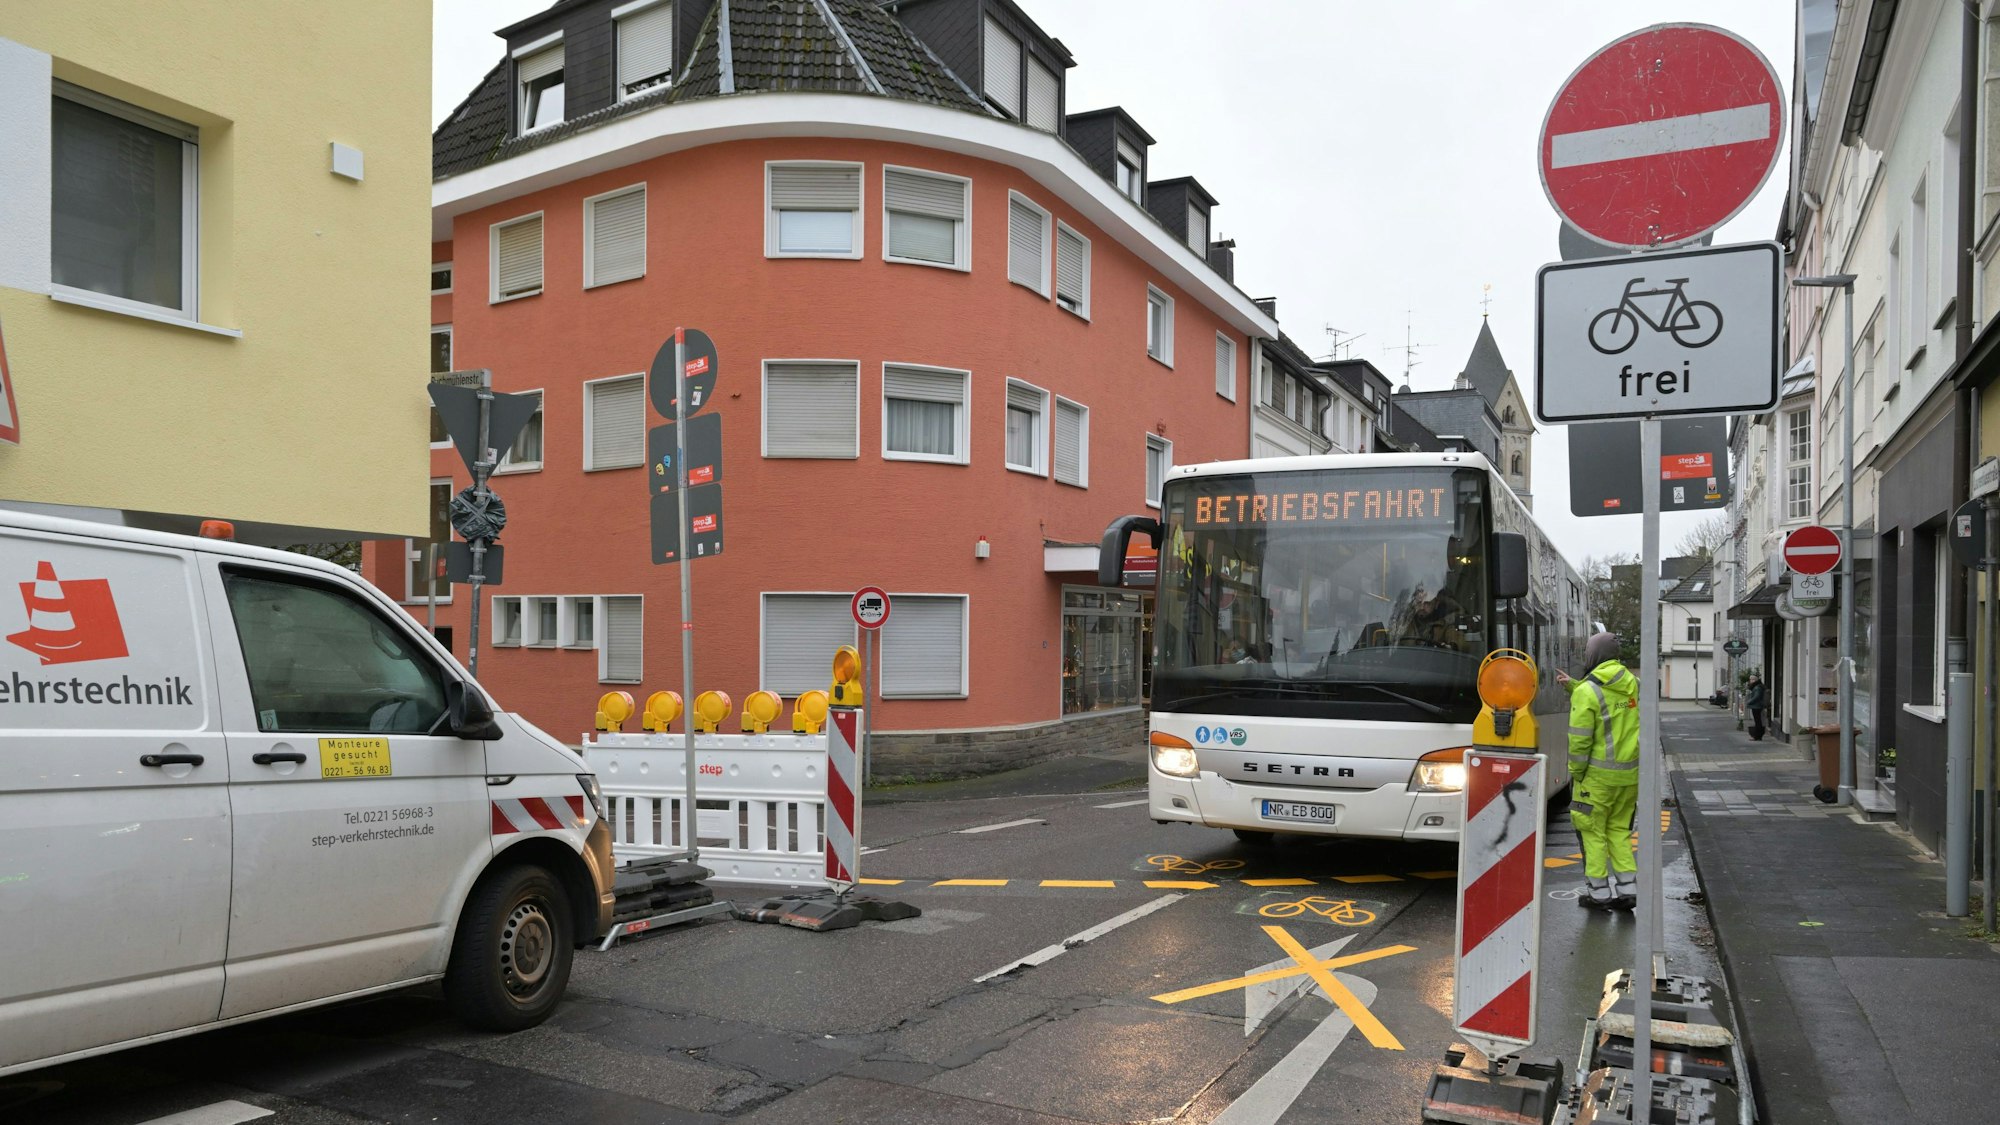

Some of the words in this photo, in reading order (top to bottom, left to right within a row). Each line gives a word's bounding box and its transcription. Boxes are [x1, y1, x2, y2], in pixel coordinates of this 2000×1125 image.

[1619, 360, 1690, 397] frei
[1196, 488, 1445, 524] BETRIEBSFAHRT
[328, 740, 381, 748] Monteure
[334, 751, 378, 761] gesucht
[324, 767, 344, 777] 0221
[354, 766, 363, 775] 56
[367, 765, 376, 774] 96
[380, 765, 389, 773] 83
[699, 764, 723, 776] step
[1243, 762, 1354, 778] SETRA
[392, 806, 434, 821] 56968-3
[1269, 803, 1284, 816] NR
[1292, 805, 1307, 817] EB
[1310, 806, 1333, 819] 800
[311, 823, 434, 848] step-verkehrstechnik.de
